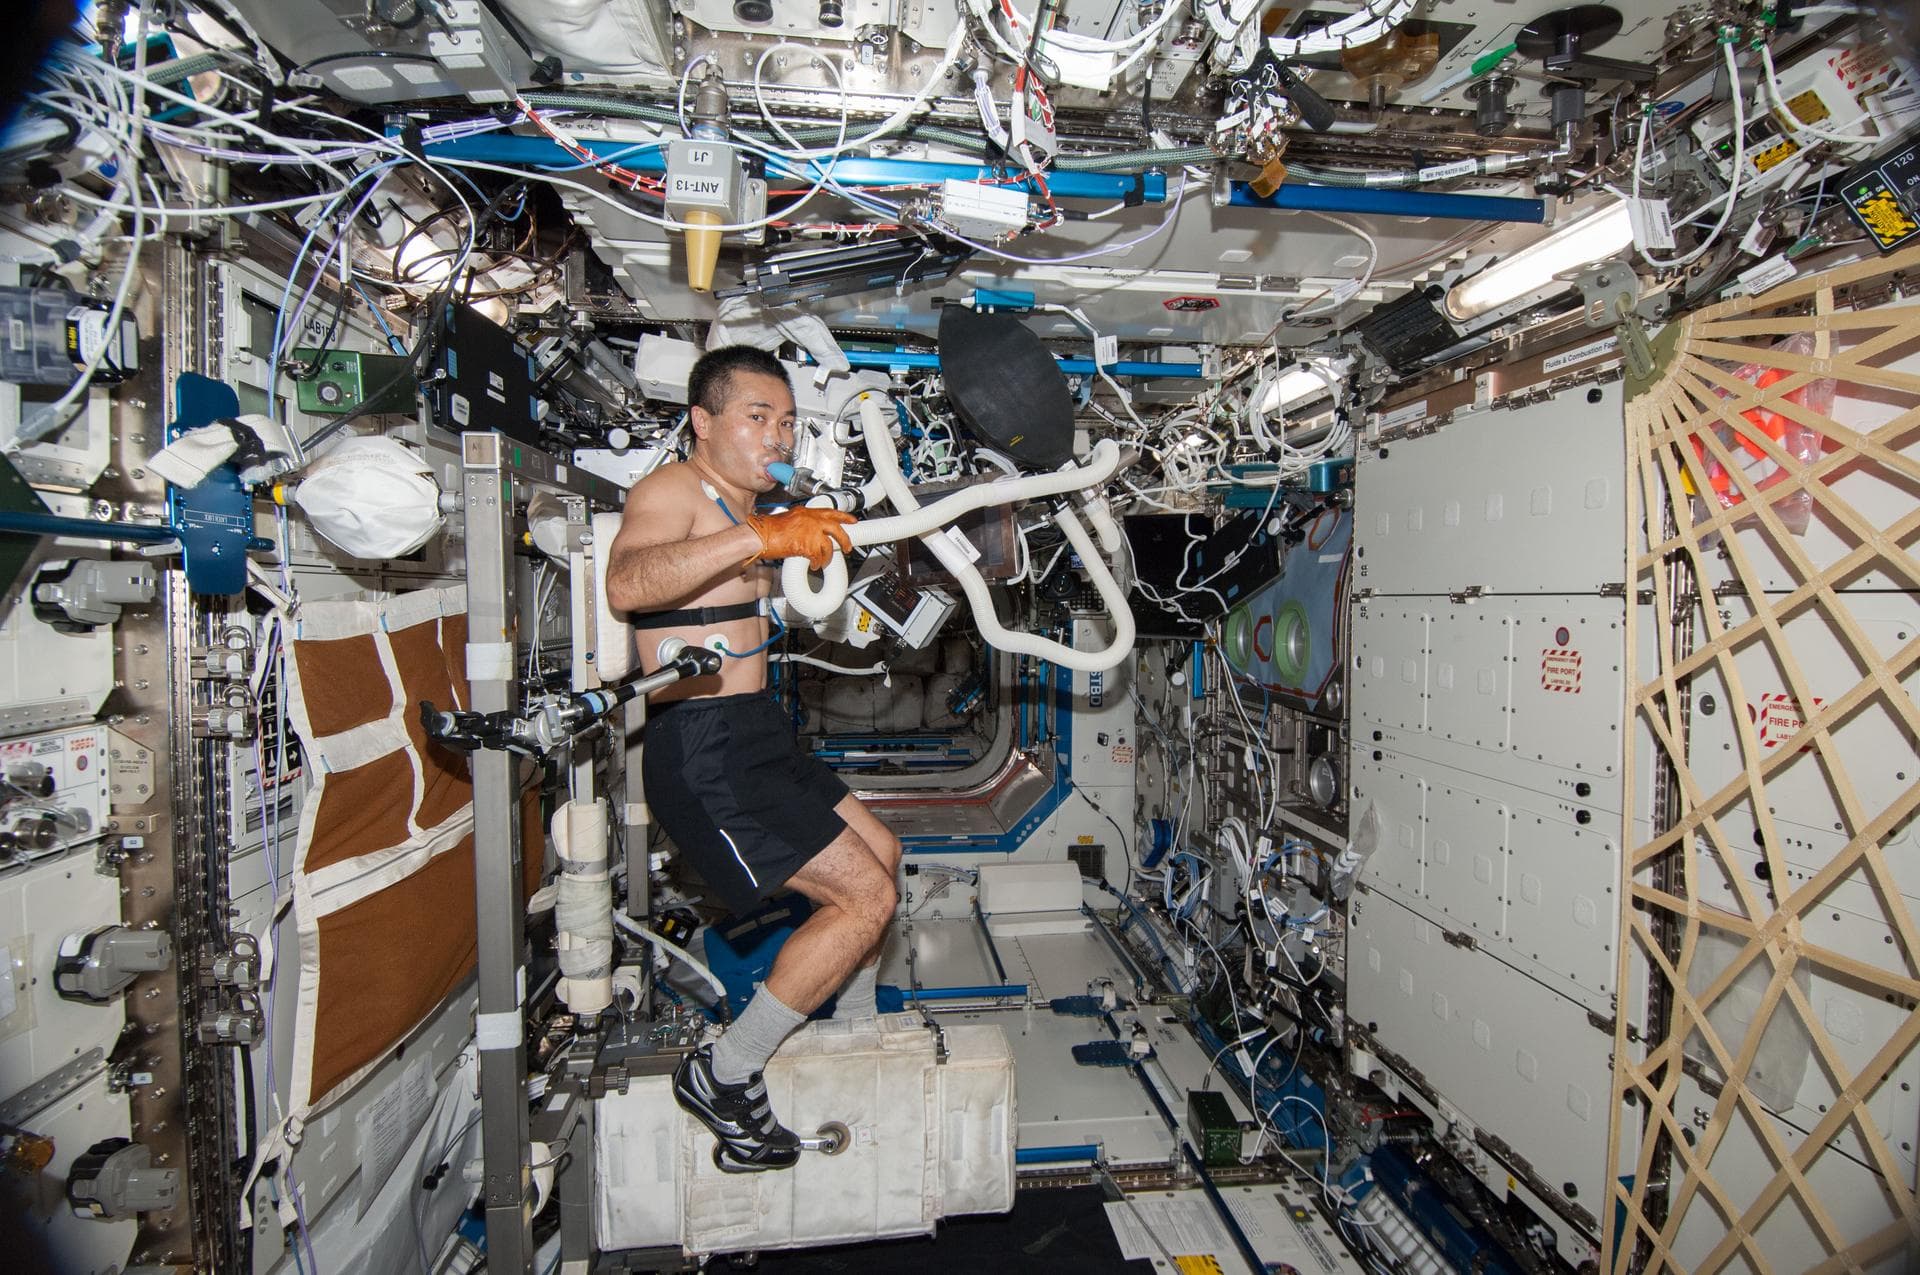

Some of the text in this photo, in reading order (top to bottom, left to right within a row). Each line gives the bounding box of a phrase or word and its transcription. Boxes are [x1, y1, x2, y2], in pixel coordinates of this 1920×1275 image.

[694, 151, 709, 162] J1
[676, 180, 719, 193] ANT-13
[1545, 359, 1561, 369] Fluids
[1567, 345, 1603, 362] Combustion
[1769, 717, 1805, 728] FIRE PO
